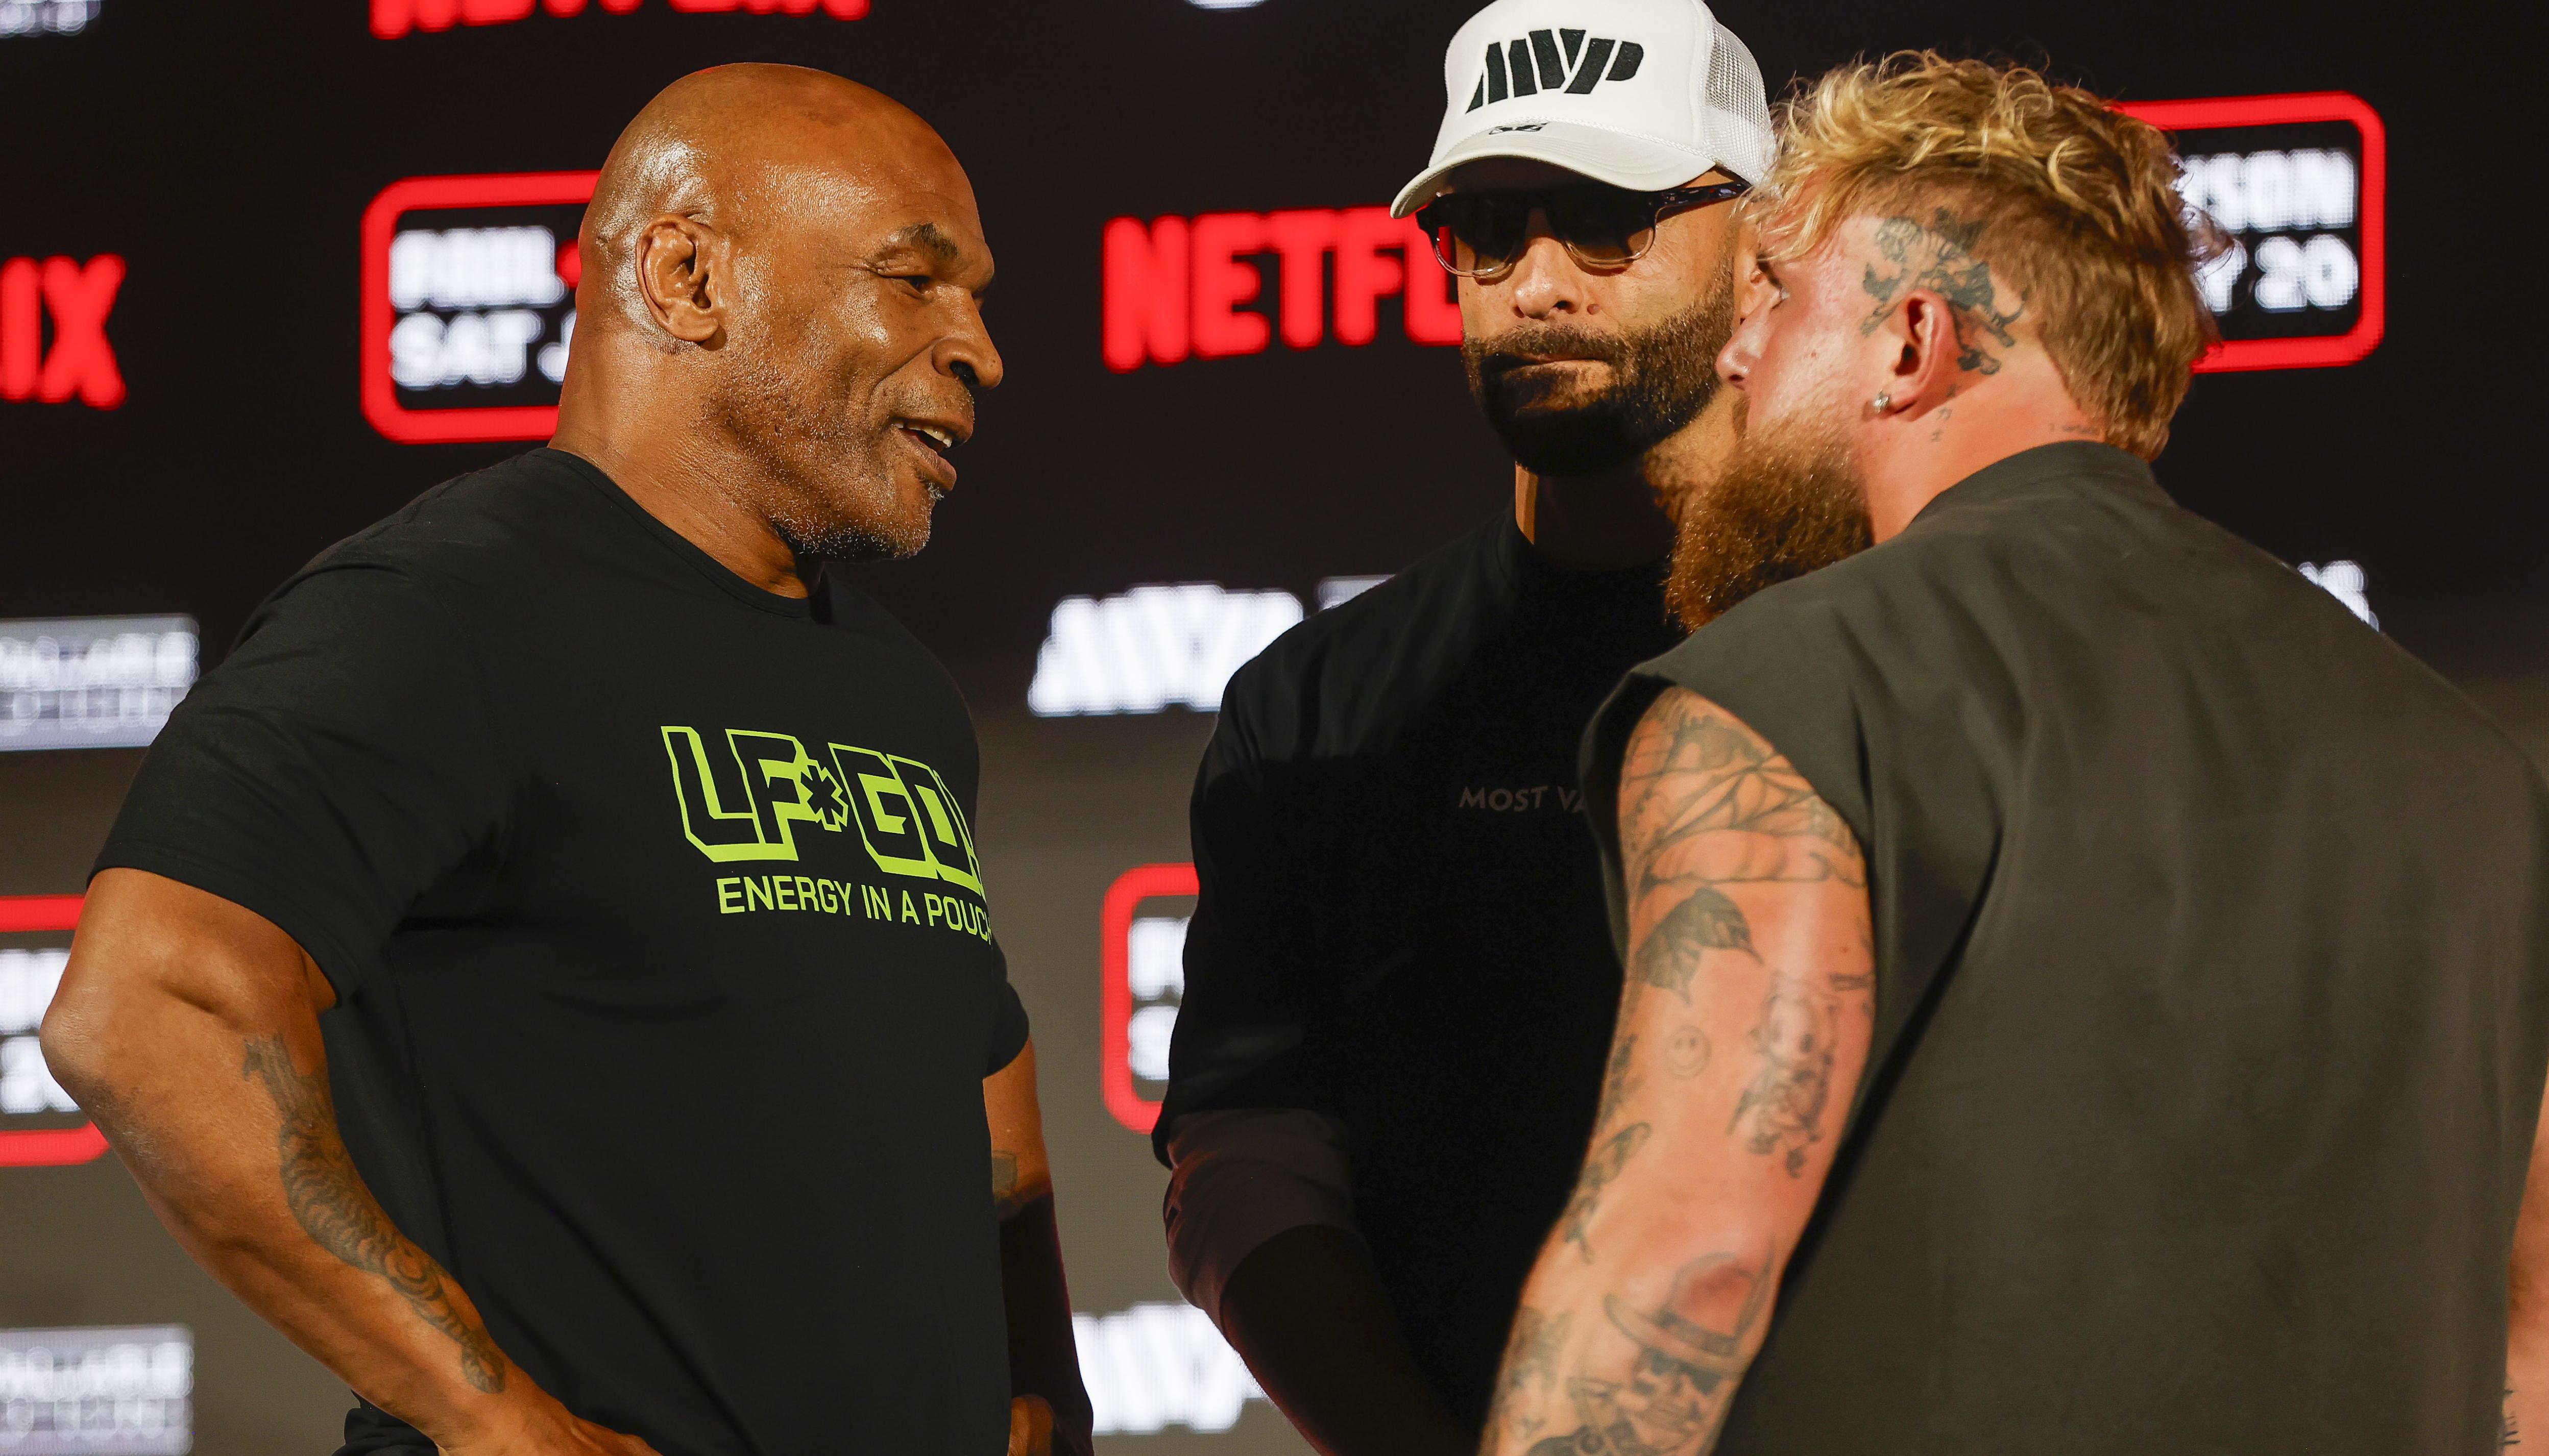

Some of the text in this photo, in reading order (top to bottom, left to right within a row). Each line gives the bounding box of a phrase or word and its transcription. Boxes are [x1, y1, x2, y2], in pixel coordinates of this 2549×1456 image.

[1465, 28, 1644, 114] MVP
[1459, 786, 1548, 812] MOST
[717, 876, 852, 916] ENERGY
[861, 884, 892, 922] IN
[902, 890, 920, 925] A
